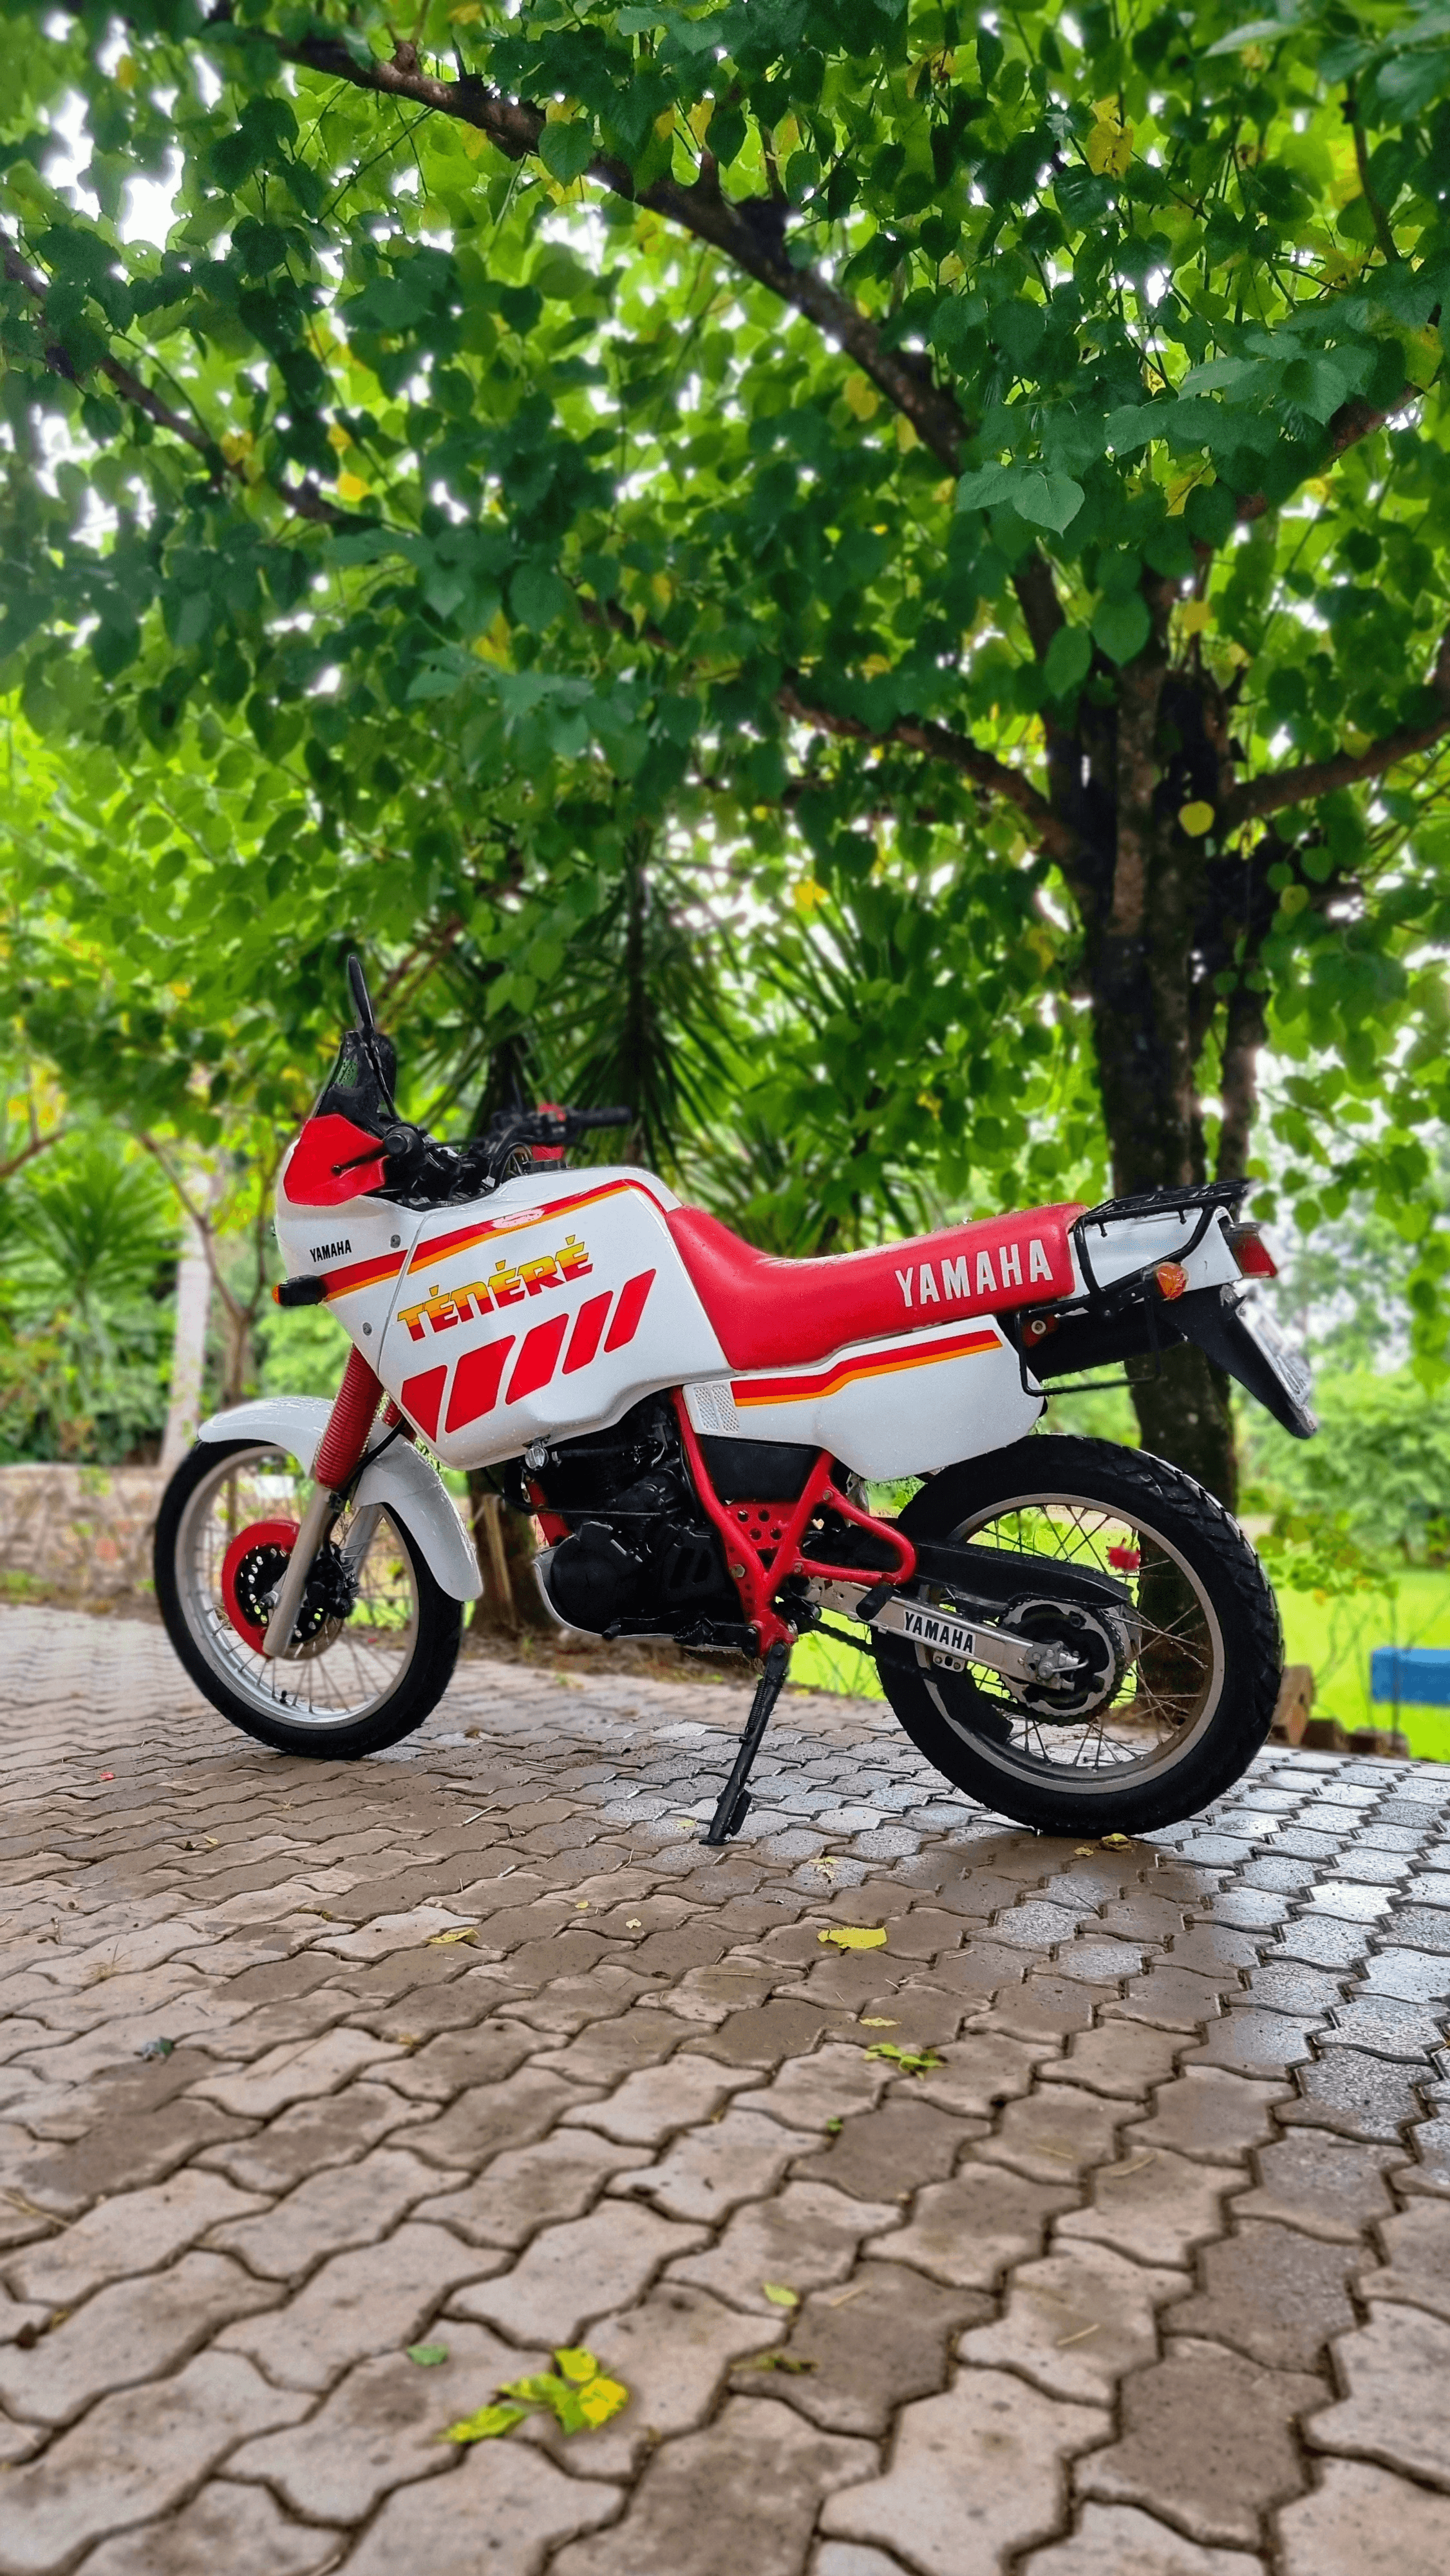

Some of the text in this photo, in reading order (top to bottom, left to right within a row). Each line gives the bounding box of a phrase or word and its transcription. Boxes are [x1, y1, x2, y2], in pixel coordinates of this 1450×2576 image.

[310, 1239, 352, 1262] YAMAHA
[895, 1239, 1053, 1307] YAMAHA
[905, 1611, 973, 1654] YAMAHA
